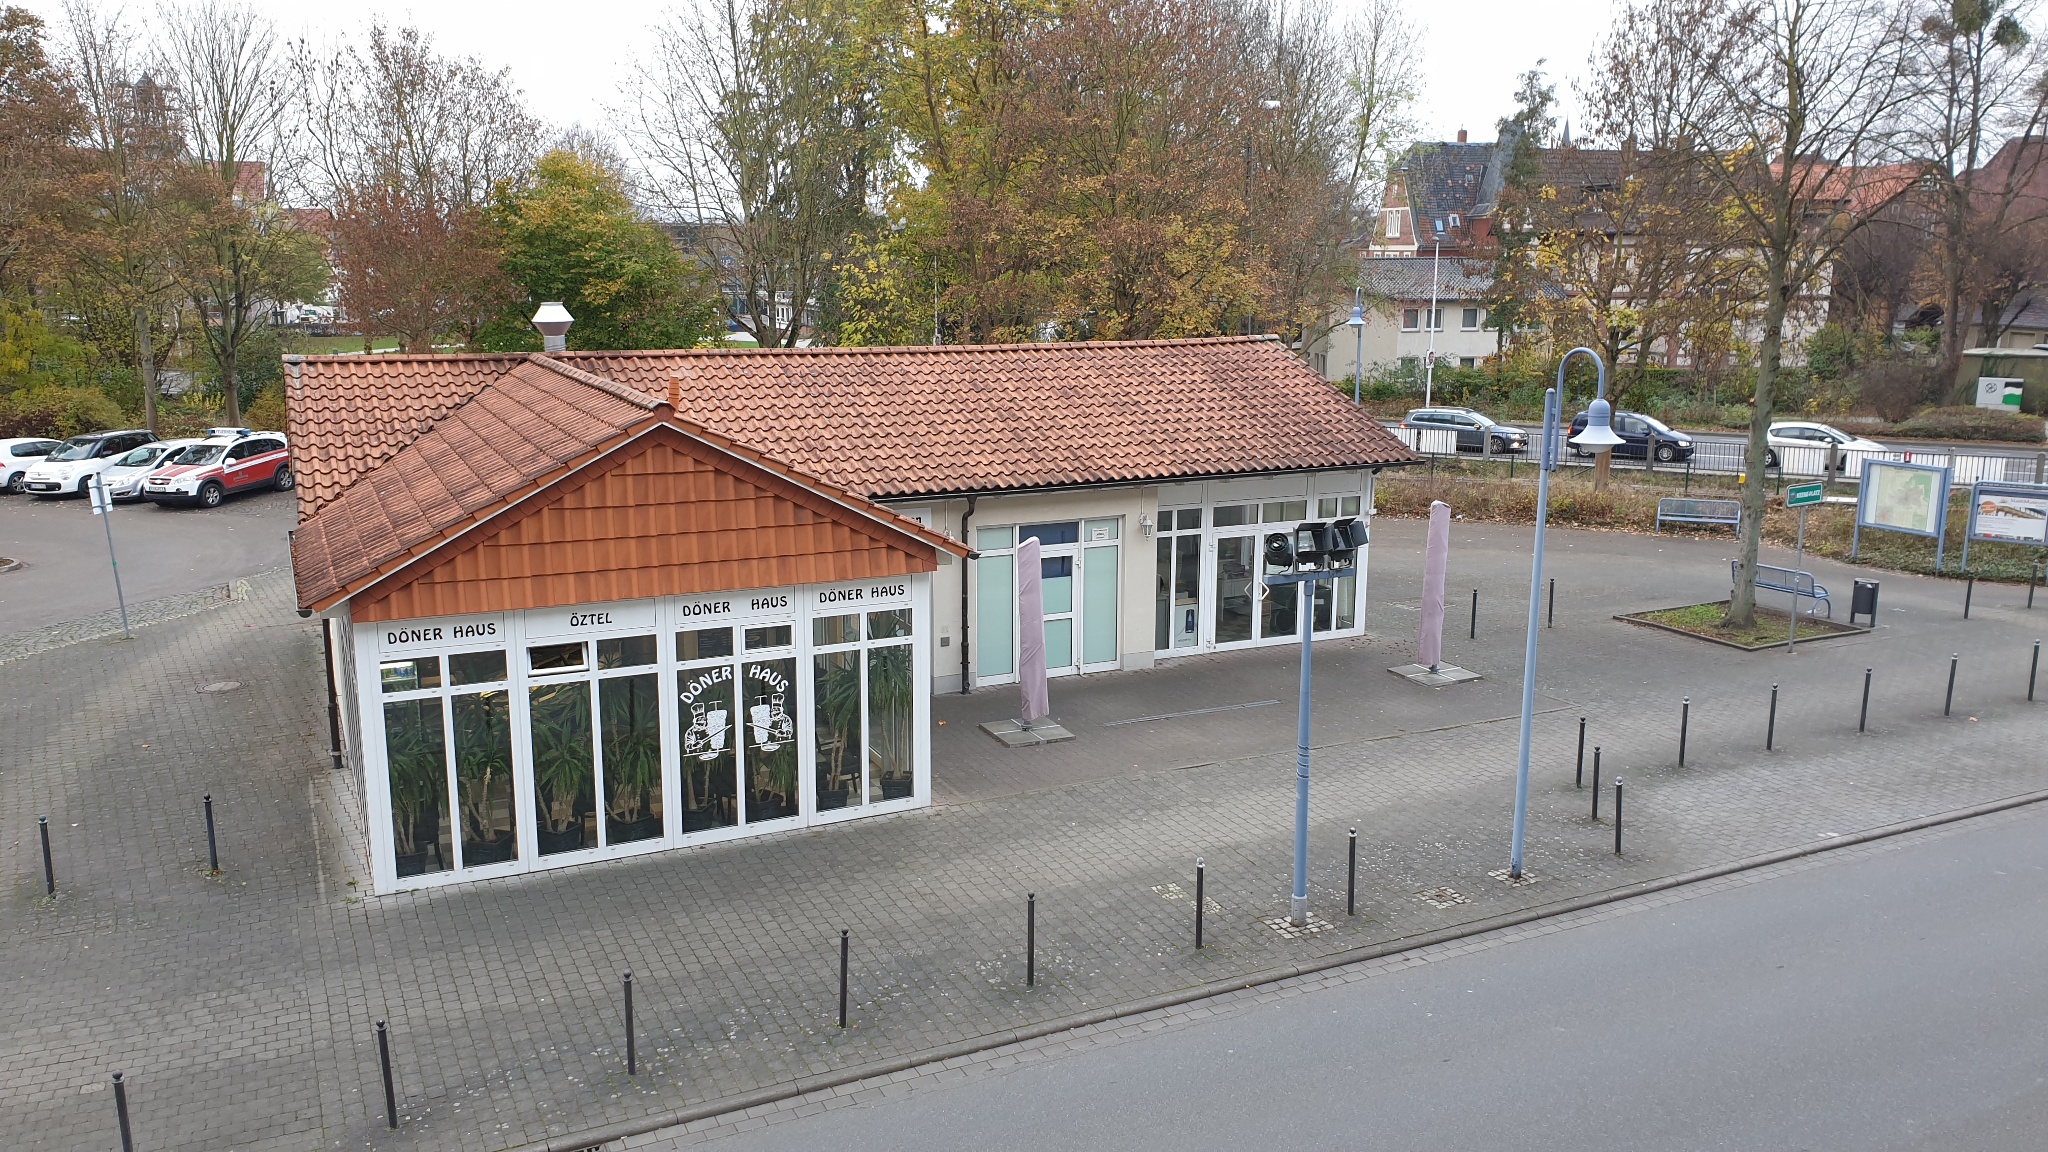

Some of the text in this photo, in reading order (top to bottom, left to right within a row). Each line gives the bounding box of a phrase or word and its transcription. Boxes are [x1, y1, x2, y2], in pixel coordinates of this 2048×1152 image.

[819, 584, 905, 604] DÖNER HAUS
[682, 595, 788, 617] DÖNER HAUS
[569, 612, 613, 627] ÖZTEL
[387, 622, 496, 645] DÖNER HAUS
[680, 664, 789, 704] DÖNER HAUS
